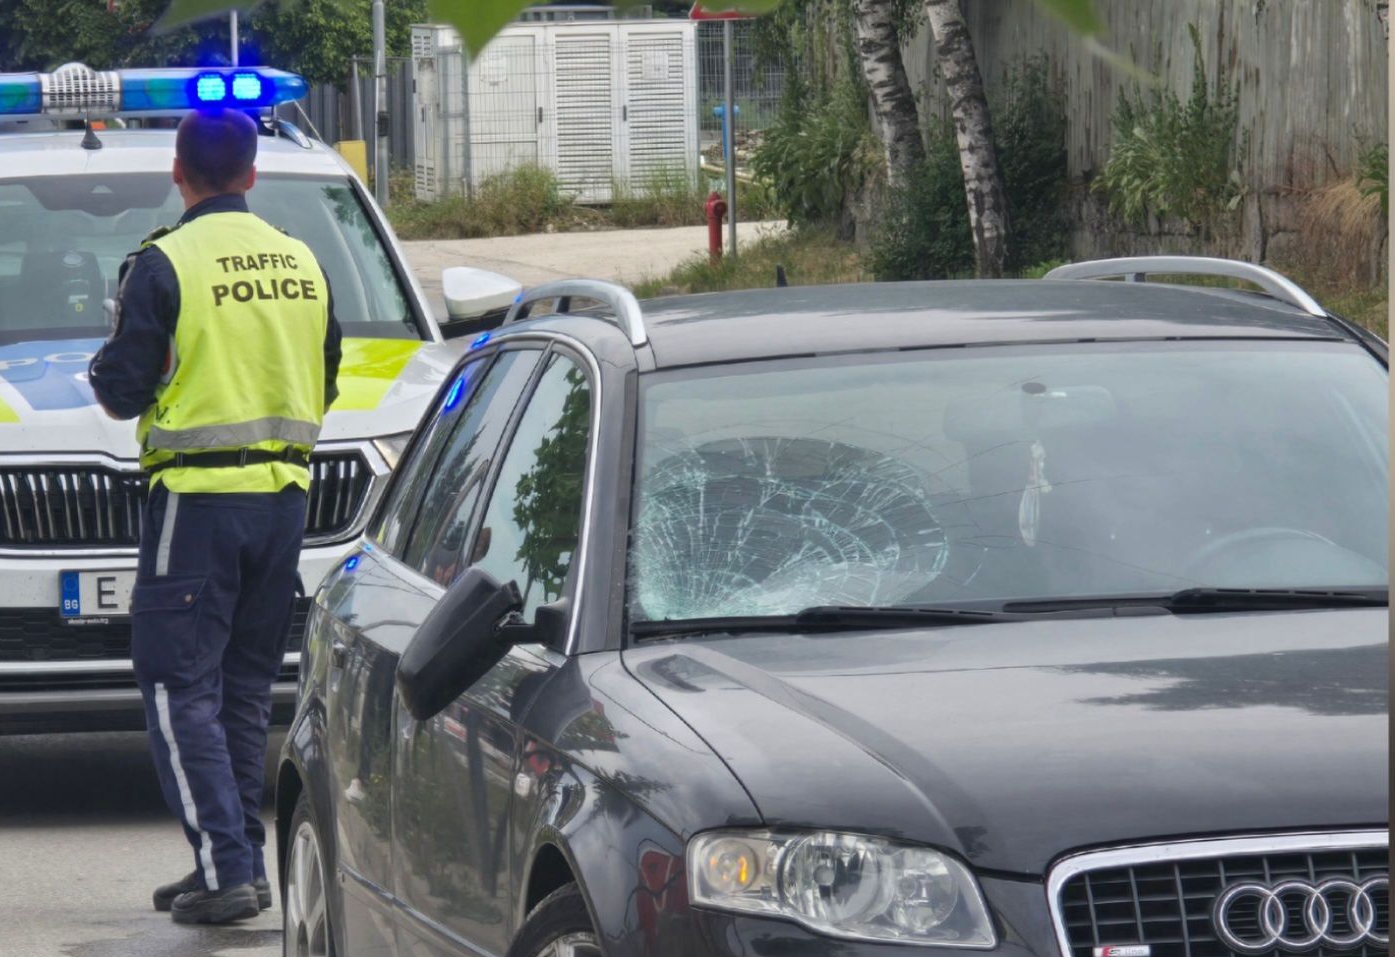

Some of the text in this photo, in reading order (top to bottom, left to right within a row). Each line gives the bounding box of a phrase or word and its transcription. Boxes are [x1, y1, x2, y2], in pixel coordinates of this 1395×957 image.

[215, 253, 298, 273] TRAFFIC
[211, 278, 318, 307] POLICE
[64, 599, 78, 610] BG
[97, 576, 119, 609] E
